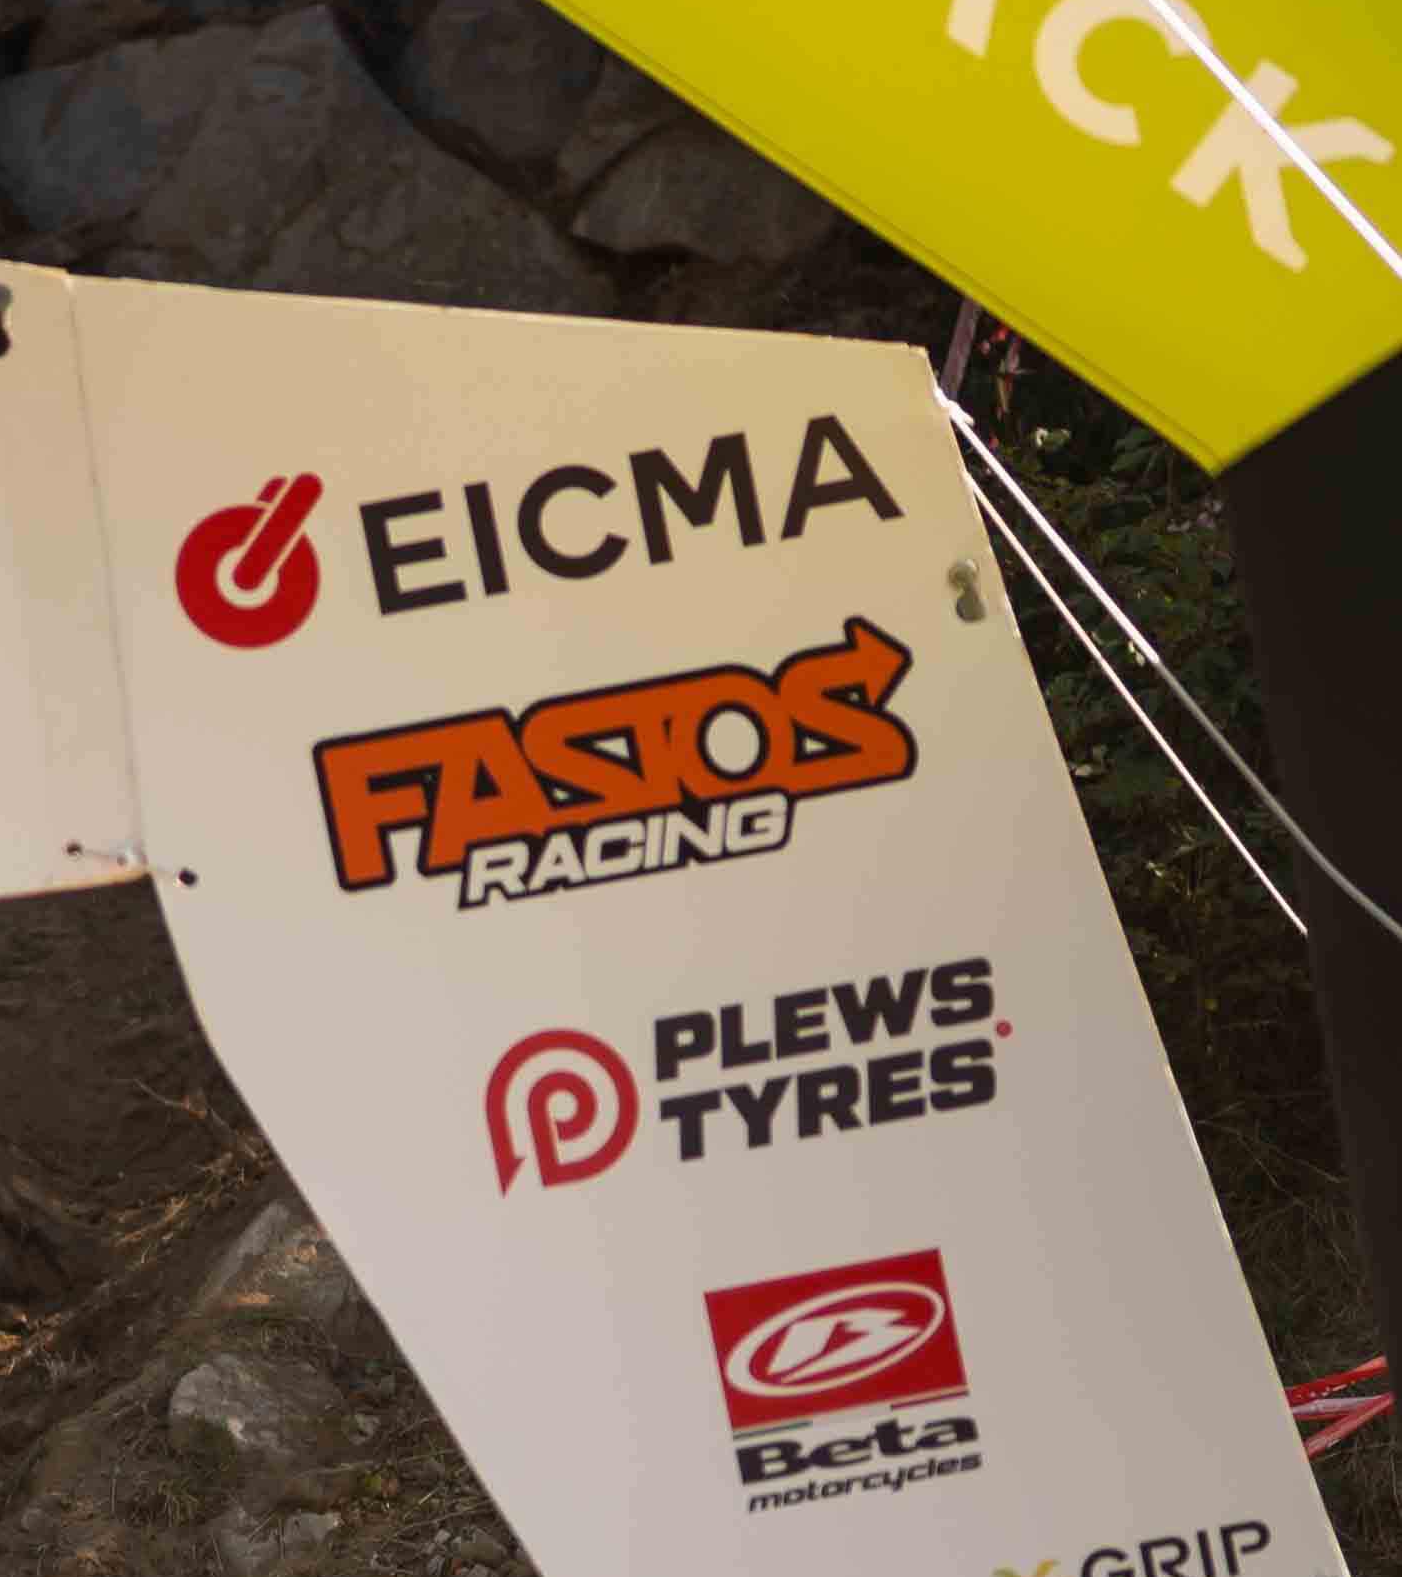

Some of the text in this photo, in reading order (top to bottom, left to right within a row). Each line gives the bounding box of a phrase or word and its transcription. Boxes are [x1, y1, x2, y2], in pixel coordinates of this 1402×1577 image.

[359, 414, 904, 616] EICMA
[313, 616, 917, 891] FASTOS
[459, 791, 797, 909] RACING
[654, 956, 994, 1083] PLEWS
[660, 1039, 997, 1162] TYRES
[735, 1414, 979, 1487] Beta
[746, 1450, 984, 1513] motorcycles
